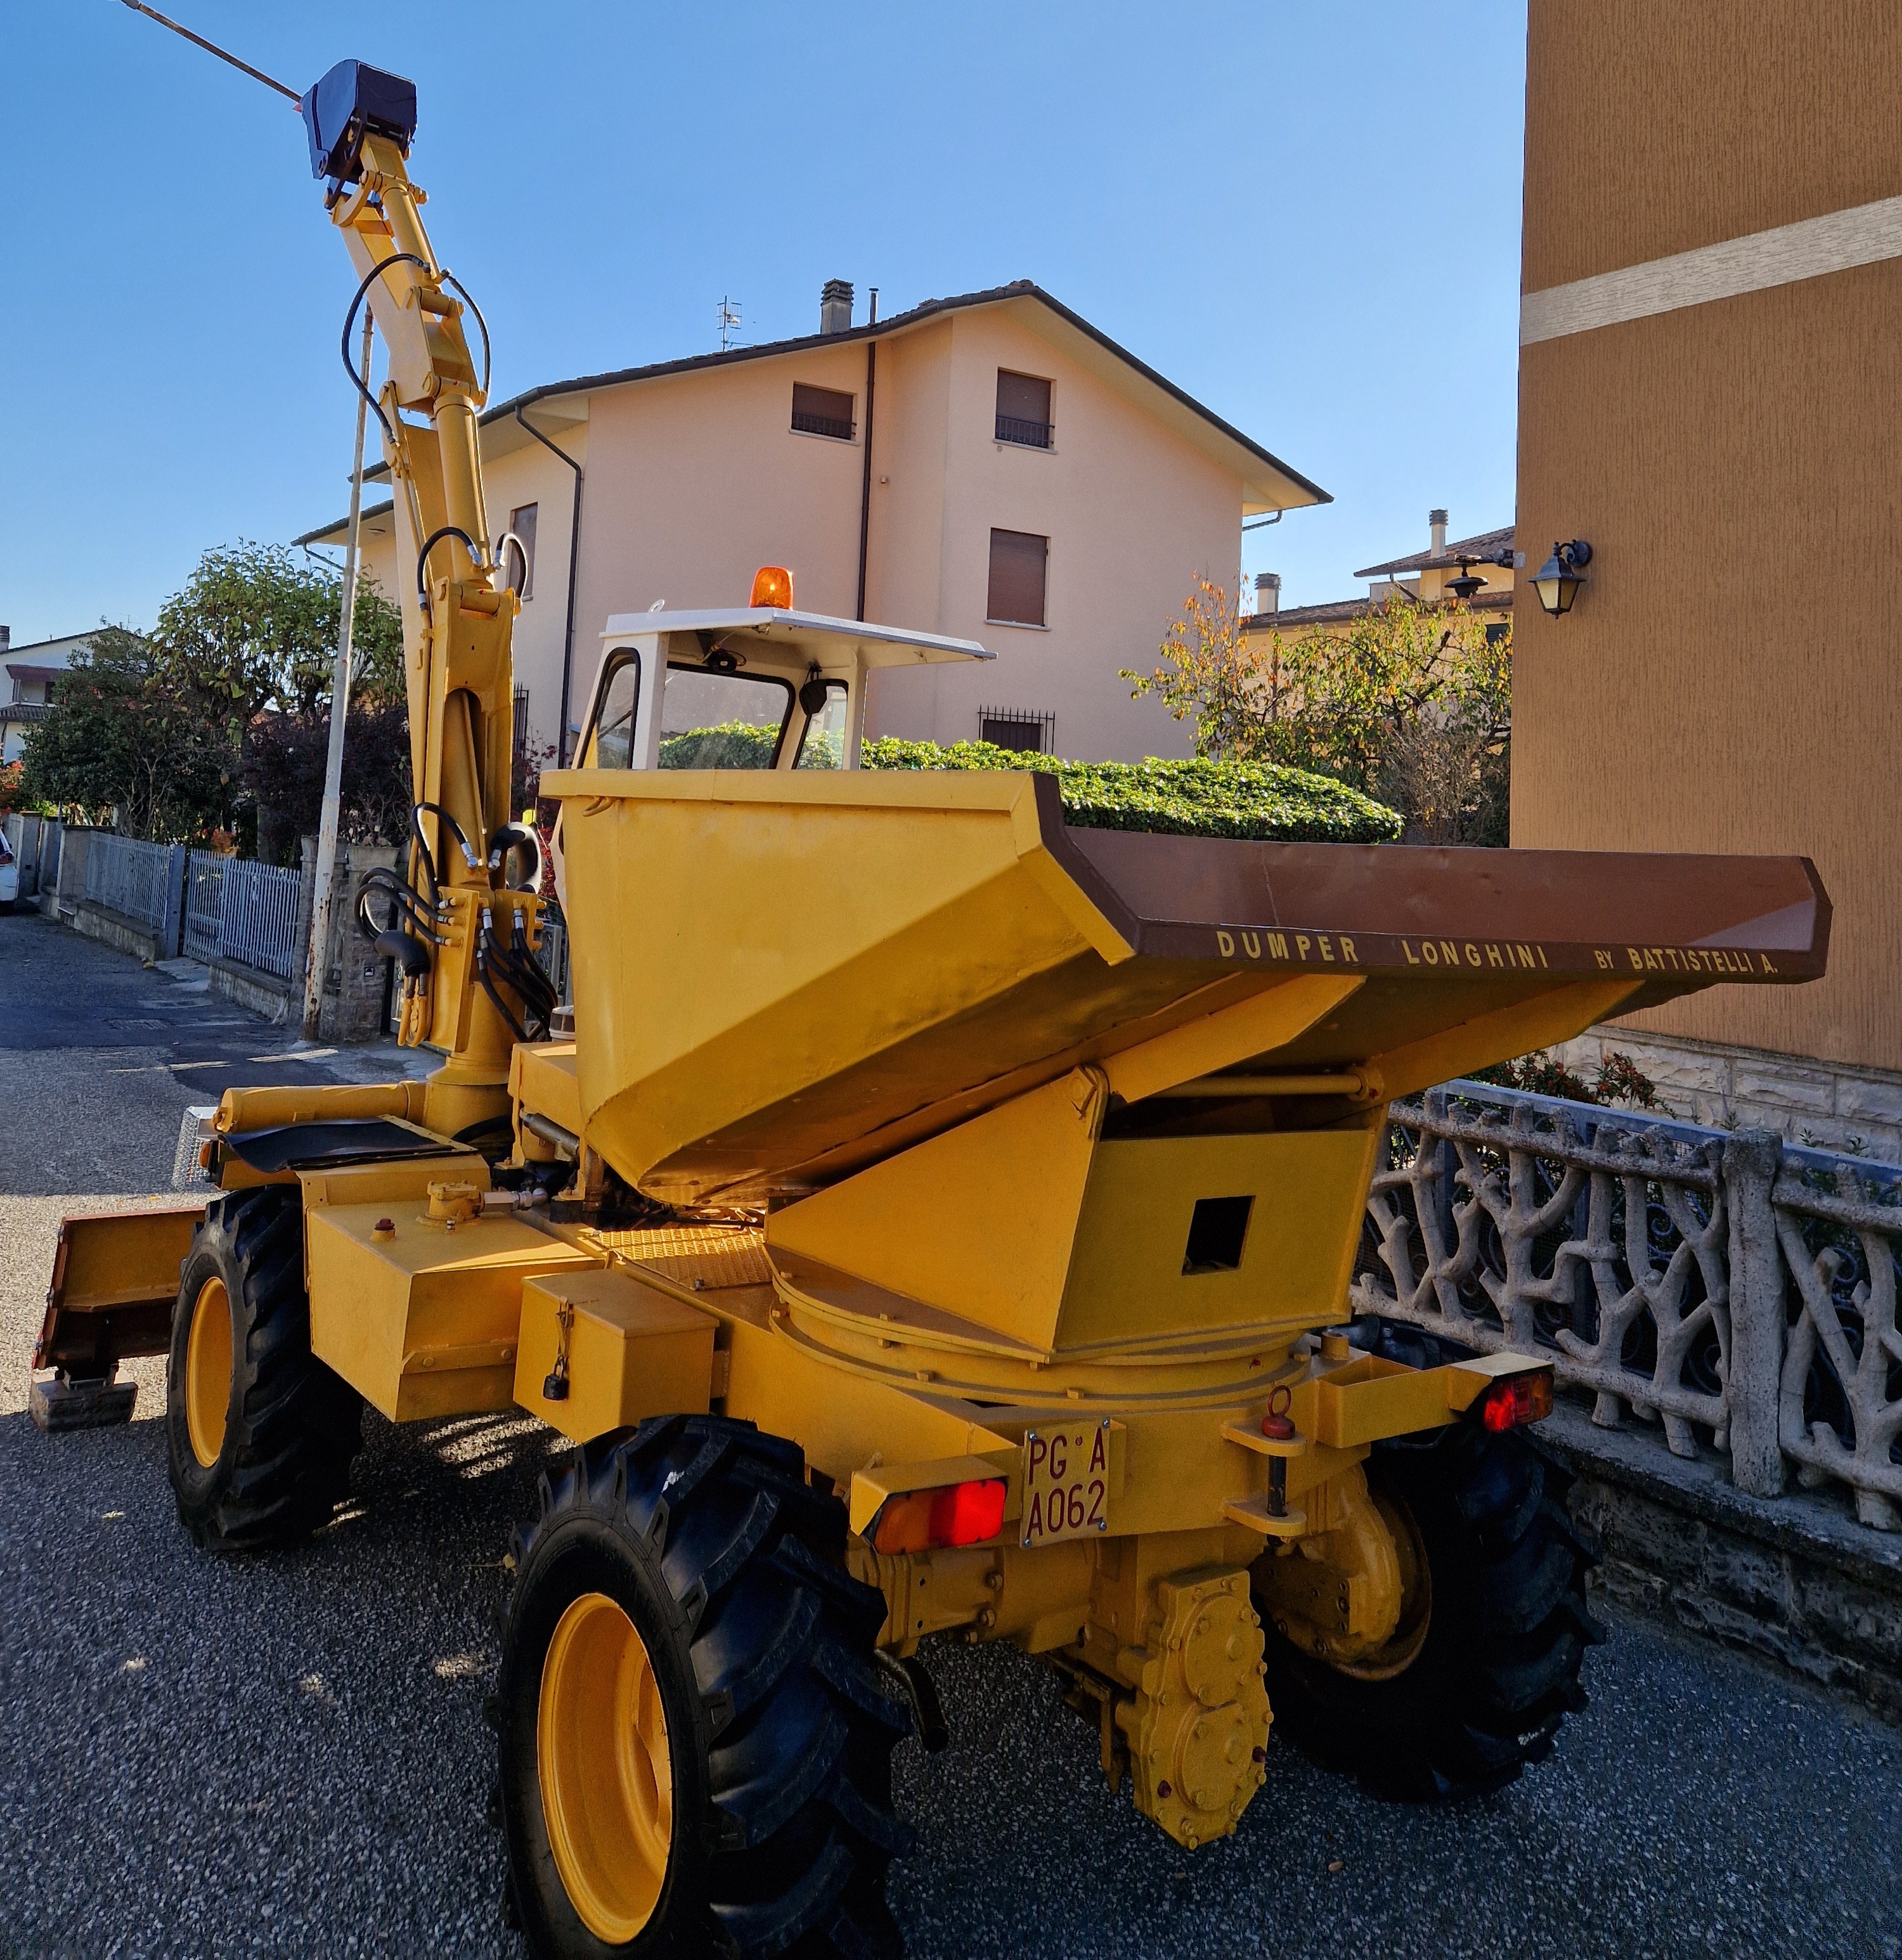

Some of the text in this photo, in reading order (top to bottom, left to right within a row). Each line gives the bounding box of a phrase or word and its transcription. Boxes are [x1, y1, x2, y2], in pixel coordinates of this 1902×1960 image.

[1216, 931, 1778, 974] DUMPER LONGHINI BY BATTISTELLI A.
[1028, 1428, 1106, 1485] PG A
[1026, 1480, 1104, 1538] A062
